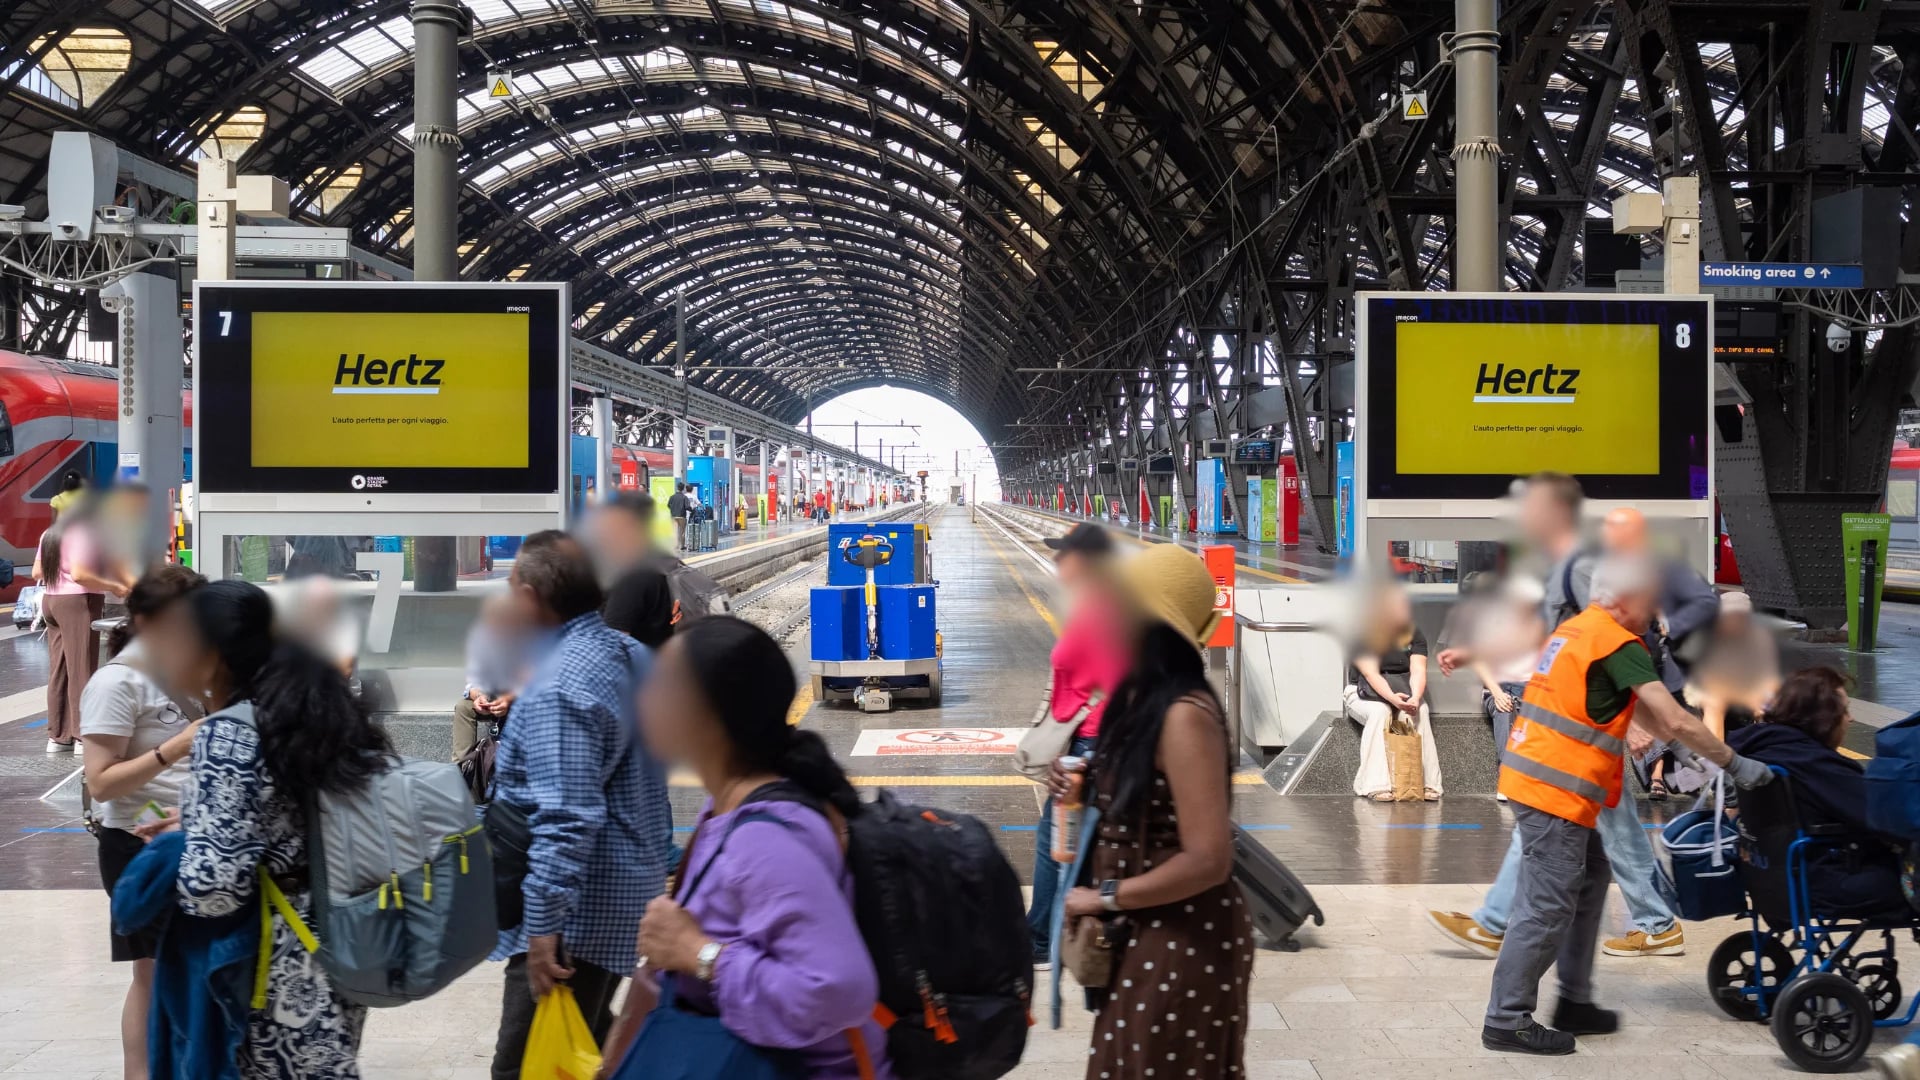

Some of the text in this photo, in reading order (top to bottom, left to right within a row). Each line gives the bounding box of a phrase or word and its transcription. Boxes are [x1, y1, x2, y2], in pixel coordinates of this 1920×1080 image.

[323, 264, 333, 278] 7
[1704, 264, 1796, 280] Smoking area
[218, 311, 232, 337] 7
[1675, 323, 1691, 348] 8
[334, 353, 446, 385] Hertz
[1475, 363, 1581, 394] Hertz
[355, 417, 385, 425] perfetta
[401, 417, 418, 425] ogni
[419, 417, 449, 425] viaggio.
[1495, 425, 1524, 433] perfetta
[1539, 425, 1555, 433] ogni
[1556, 425, 1585, 433] viaggio.
[356, 552, 404, 653] 7
